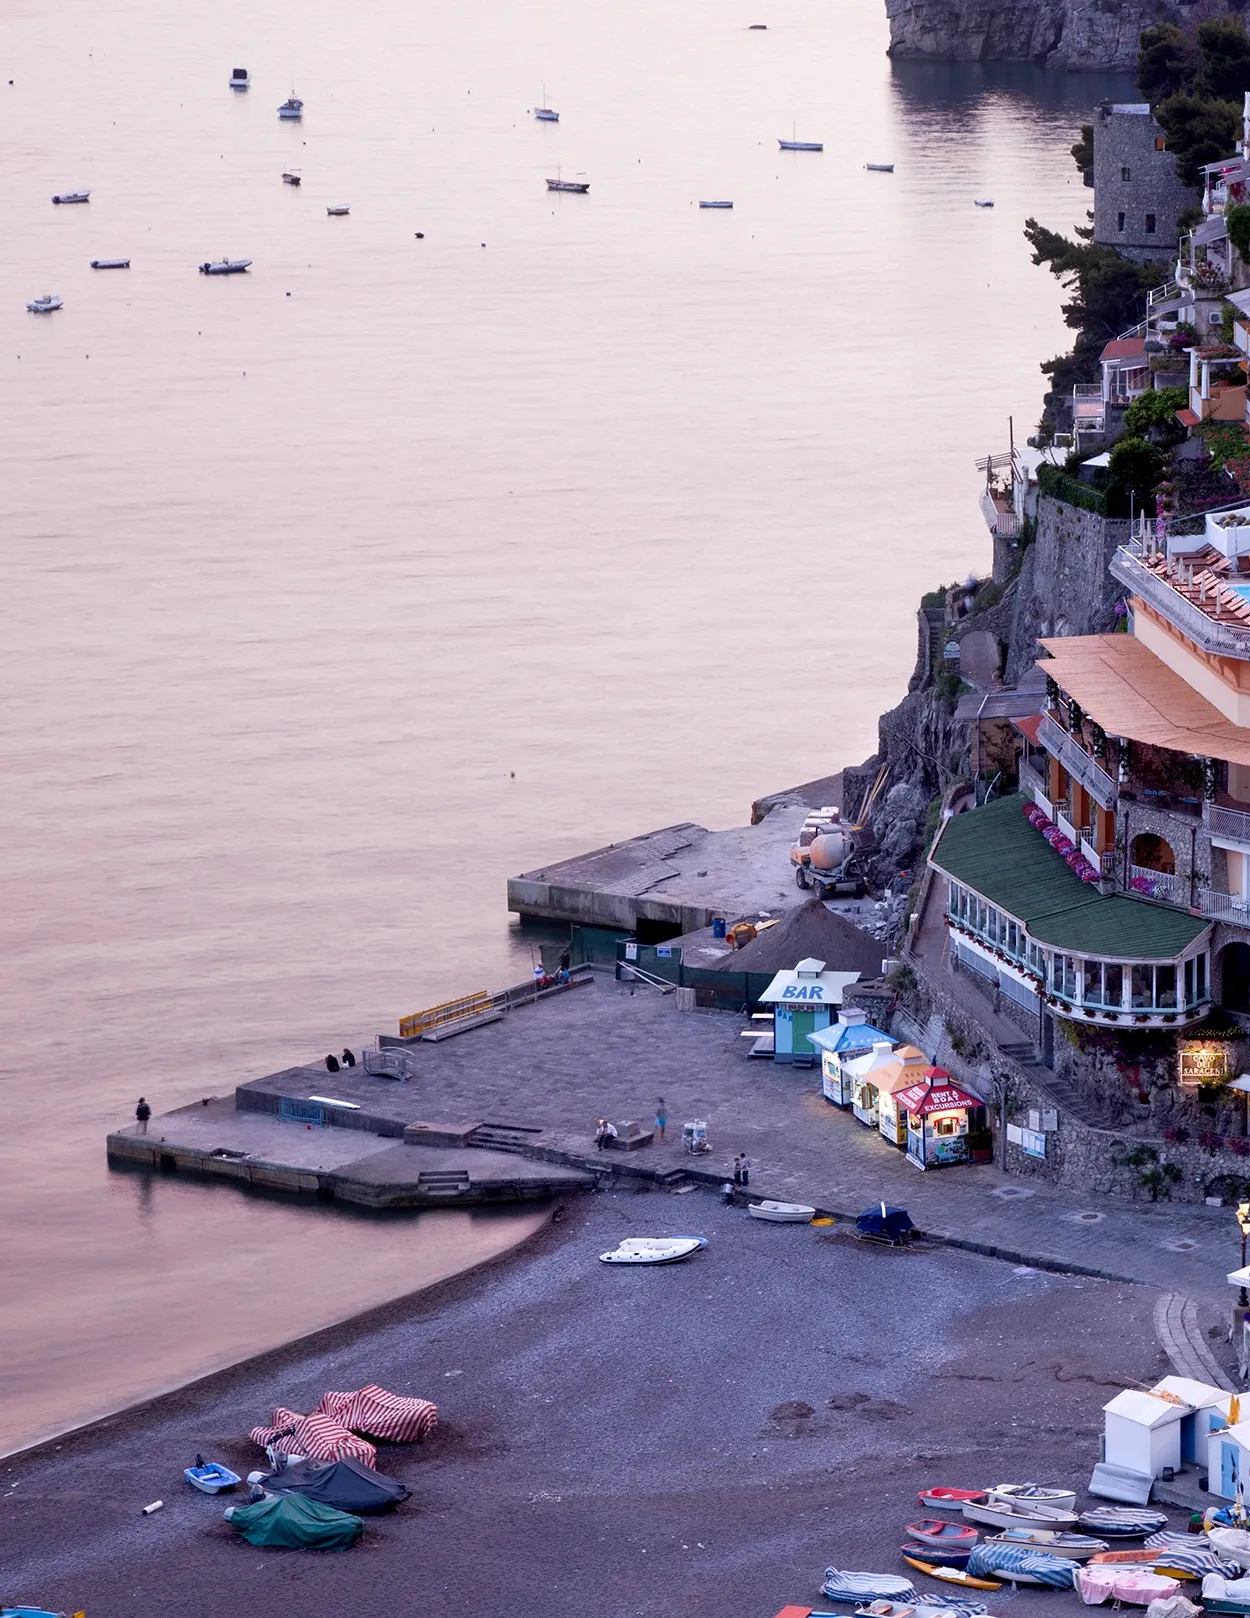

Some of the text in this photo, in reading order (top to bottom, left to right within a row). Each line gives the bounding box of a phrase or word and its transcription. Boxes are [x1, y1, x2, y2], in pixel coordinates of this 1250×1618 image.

[782, 985, 824, 1000] BAR
[777, 1009, 793, 1022] BAR
[1183, 1067, 1225, 1075] SARACENI
[931, 1091, 951, 1099] RENT
[933, 1095, 960, 1104] BOAT
[924, 1100, 973, 1112] EXCURSIONS
